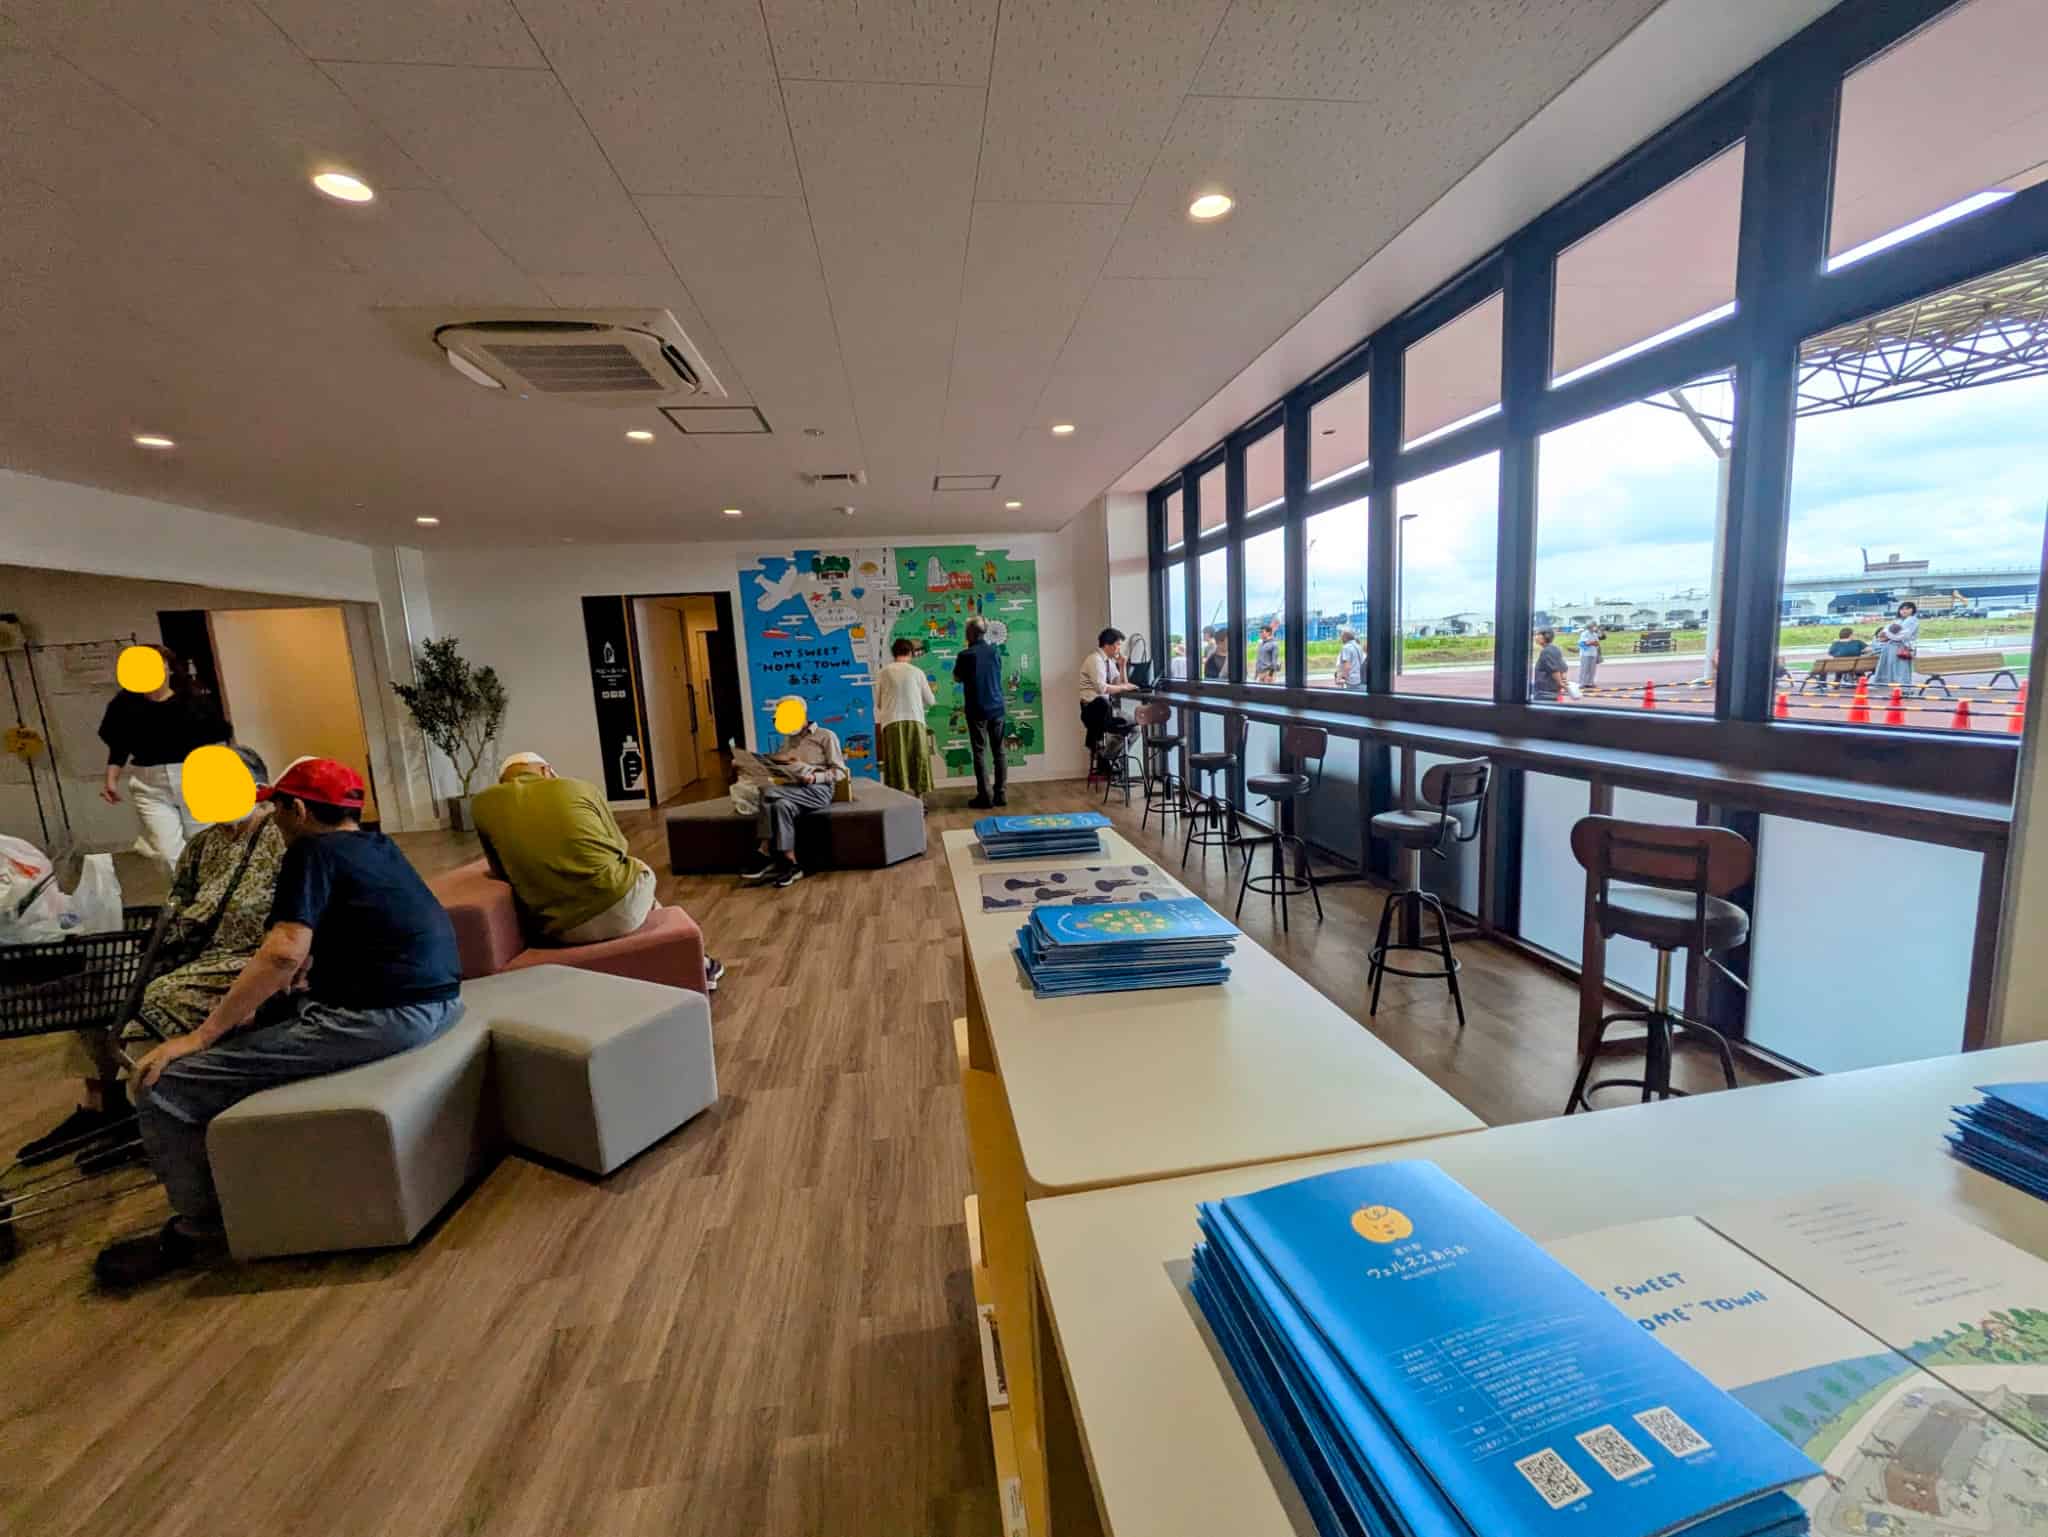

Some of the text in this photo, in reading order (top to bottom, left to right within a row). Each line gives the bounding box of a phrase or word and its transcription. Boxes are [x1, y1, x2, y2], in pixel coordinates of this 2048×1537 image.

[773, 646, 839, 658] MY SWEET
[815, 657, 850, 668] TOWN
[788, 674, 823, 685] あらお
[1614, 1271, 1687, 1300] SWEET
[1637, 1290, 1769, 1332] OME" TOWN
